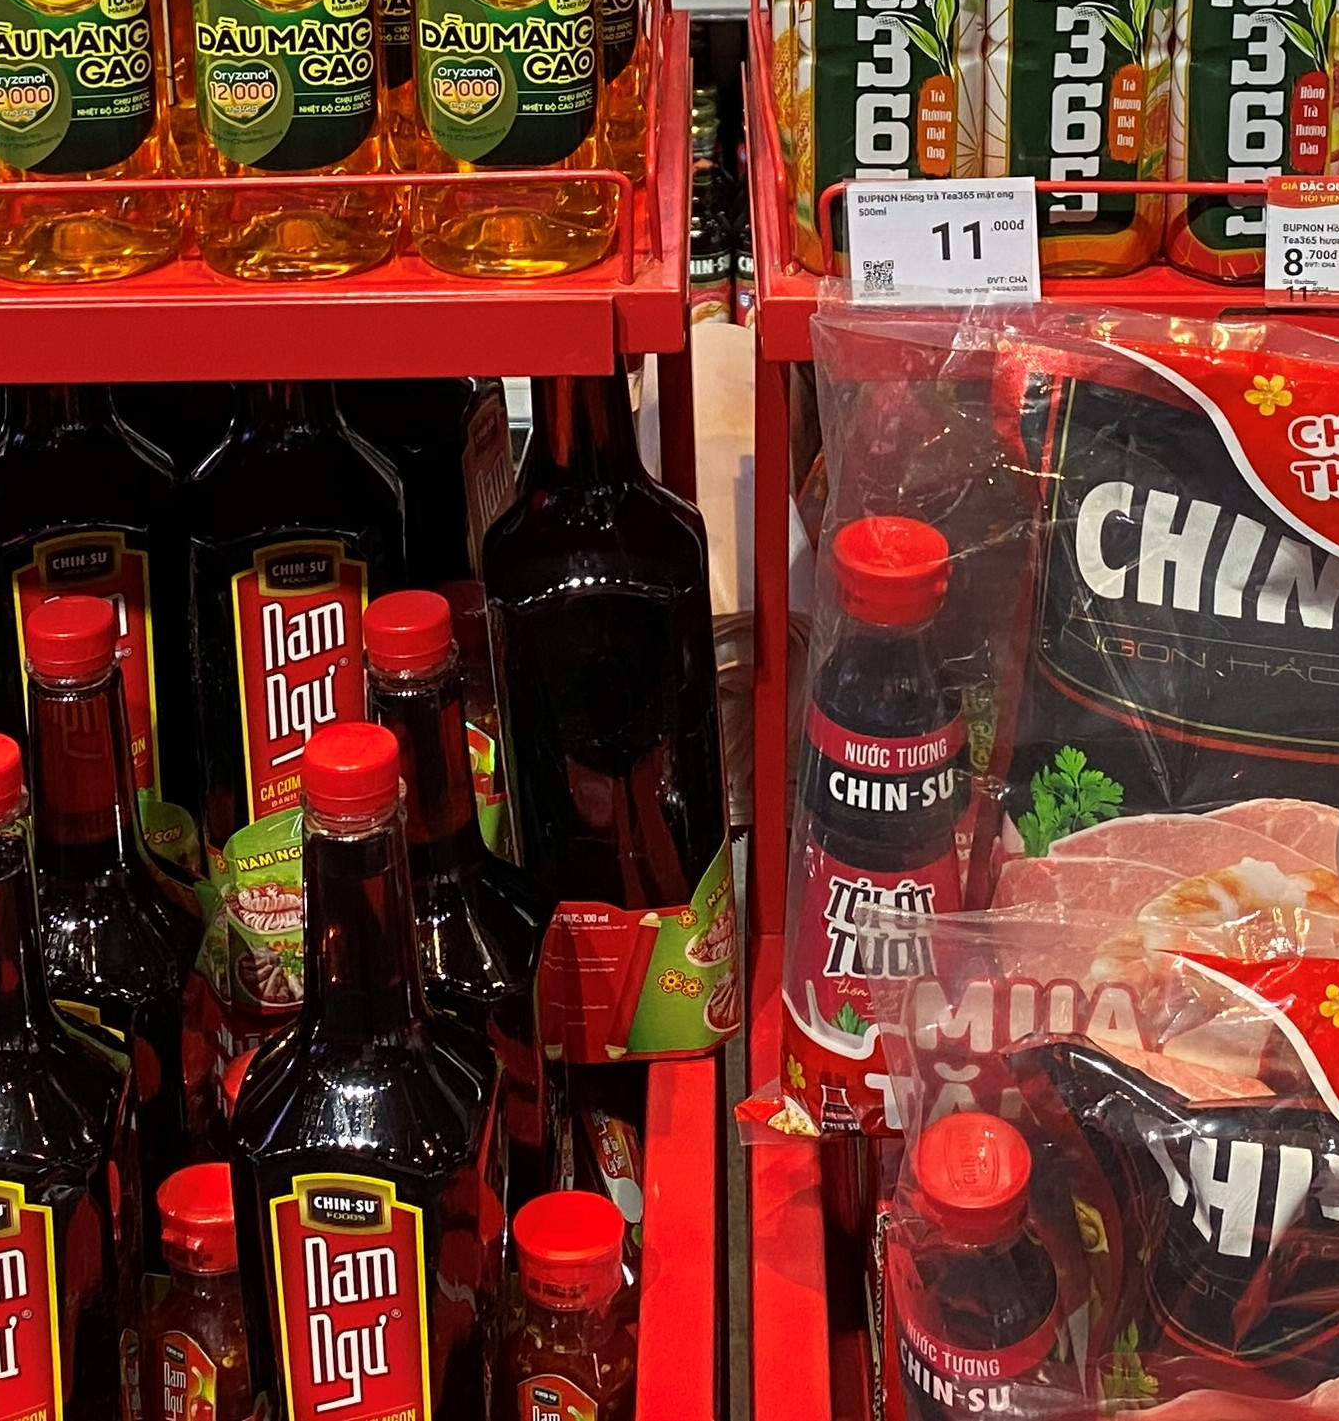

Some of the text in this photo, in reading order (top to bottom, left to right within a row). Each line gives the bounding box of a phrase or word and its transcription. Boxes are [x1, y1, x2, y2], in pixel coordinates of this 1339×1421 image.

[419, 15, 488, 53] DẦU
[523, 51, 595, 85] GẠO
[858, 195, 898, 203] BUPNON
[942, 192, 975, 200] Tea365
[859, 208, 886, 216] 500ml
[932, 221, 981, 260] 11
[1283, 224, 1324, 232] BUPNON
[1283, 236, 1316, 244] Tea365
[1284, 248, 1303, 276] 8
[272, 560, 329, 577] CHIN-SU
[263, 602, 346, 671] Nam
[845, 735, 948, 771] NƯỚC TƯƠNG
[830, 771, 954, 813] CHIN-SU
[314, 1197, 378, 1214] CHIN-SU
[306, 1237, 396, 1308] Nam
